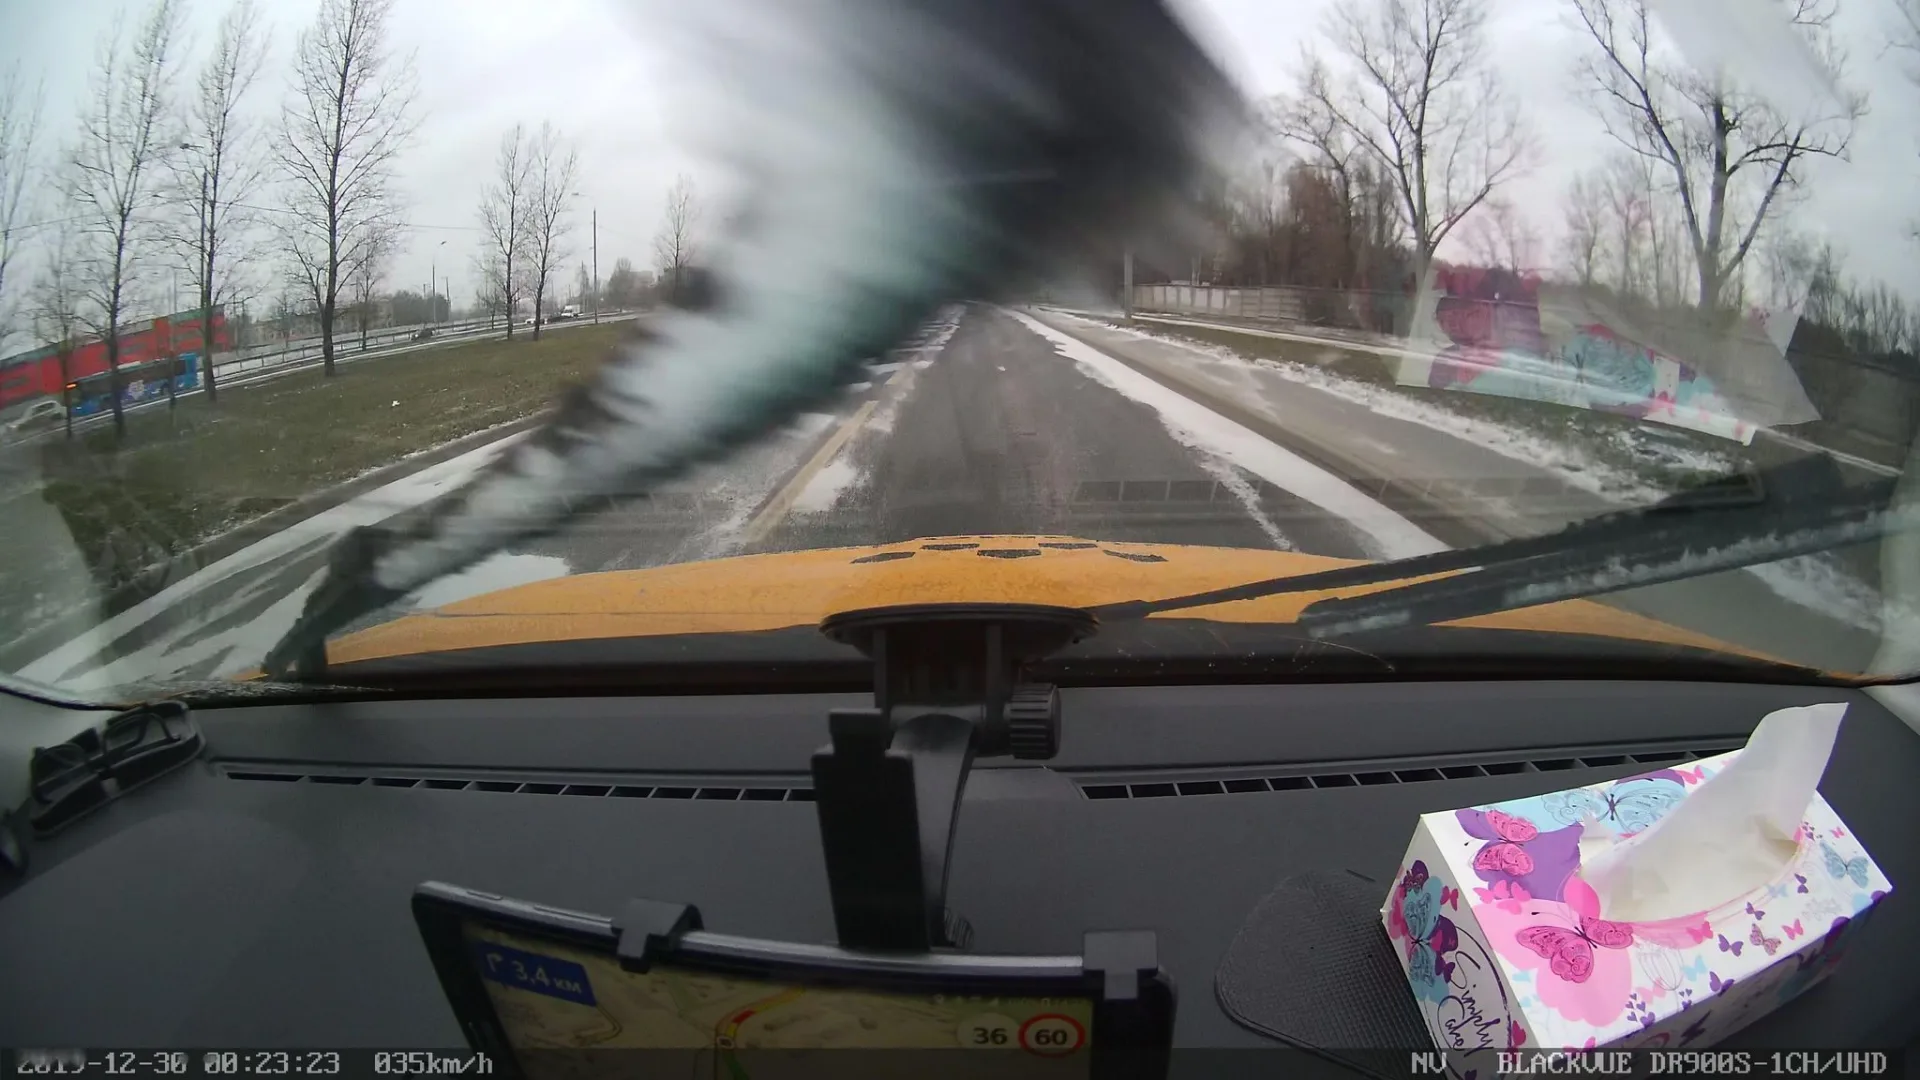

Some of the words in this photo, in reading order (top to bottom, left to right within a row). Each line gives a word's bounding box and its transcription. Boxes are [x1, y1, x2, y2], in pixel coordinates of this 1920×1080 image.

[512, 961, 550, 987] 3,4
[1450, 951, 1501, 1058] Simply
[973, 1027, 1008, 1045] 36
[1035, 1029, 1068, 1046] 60
